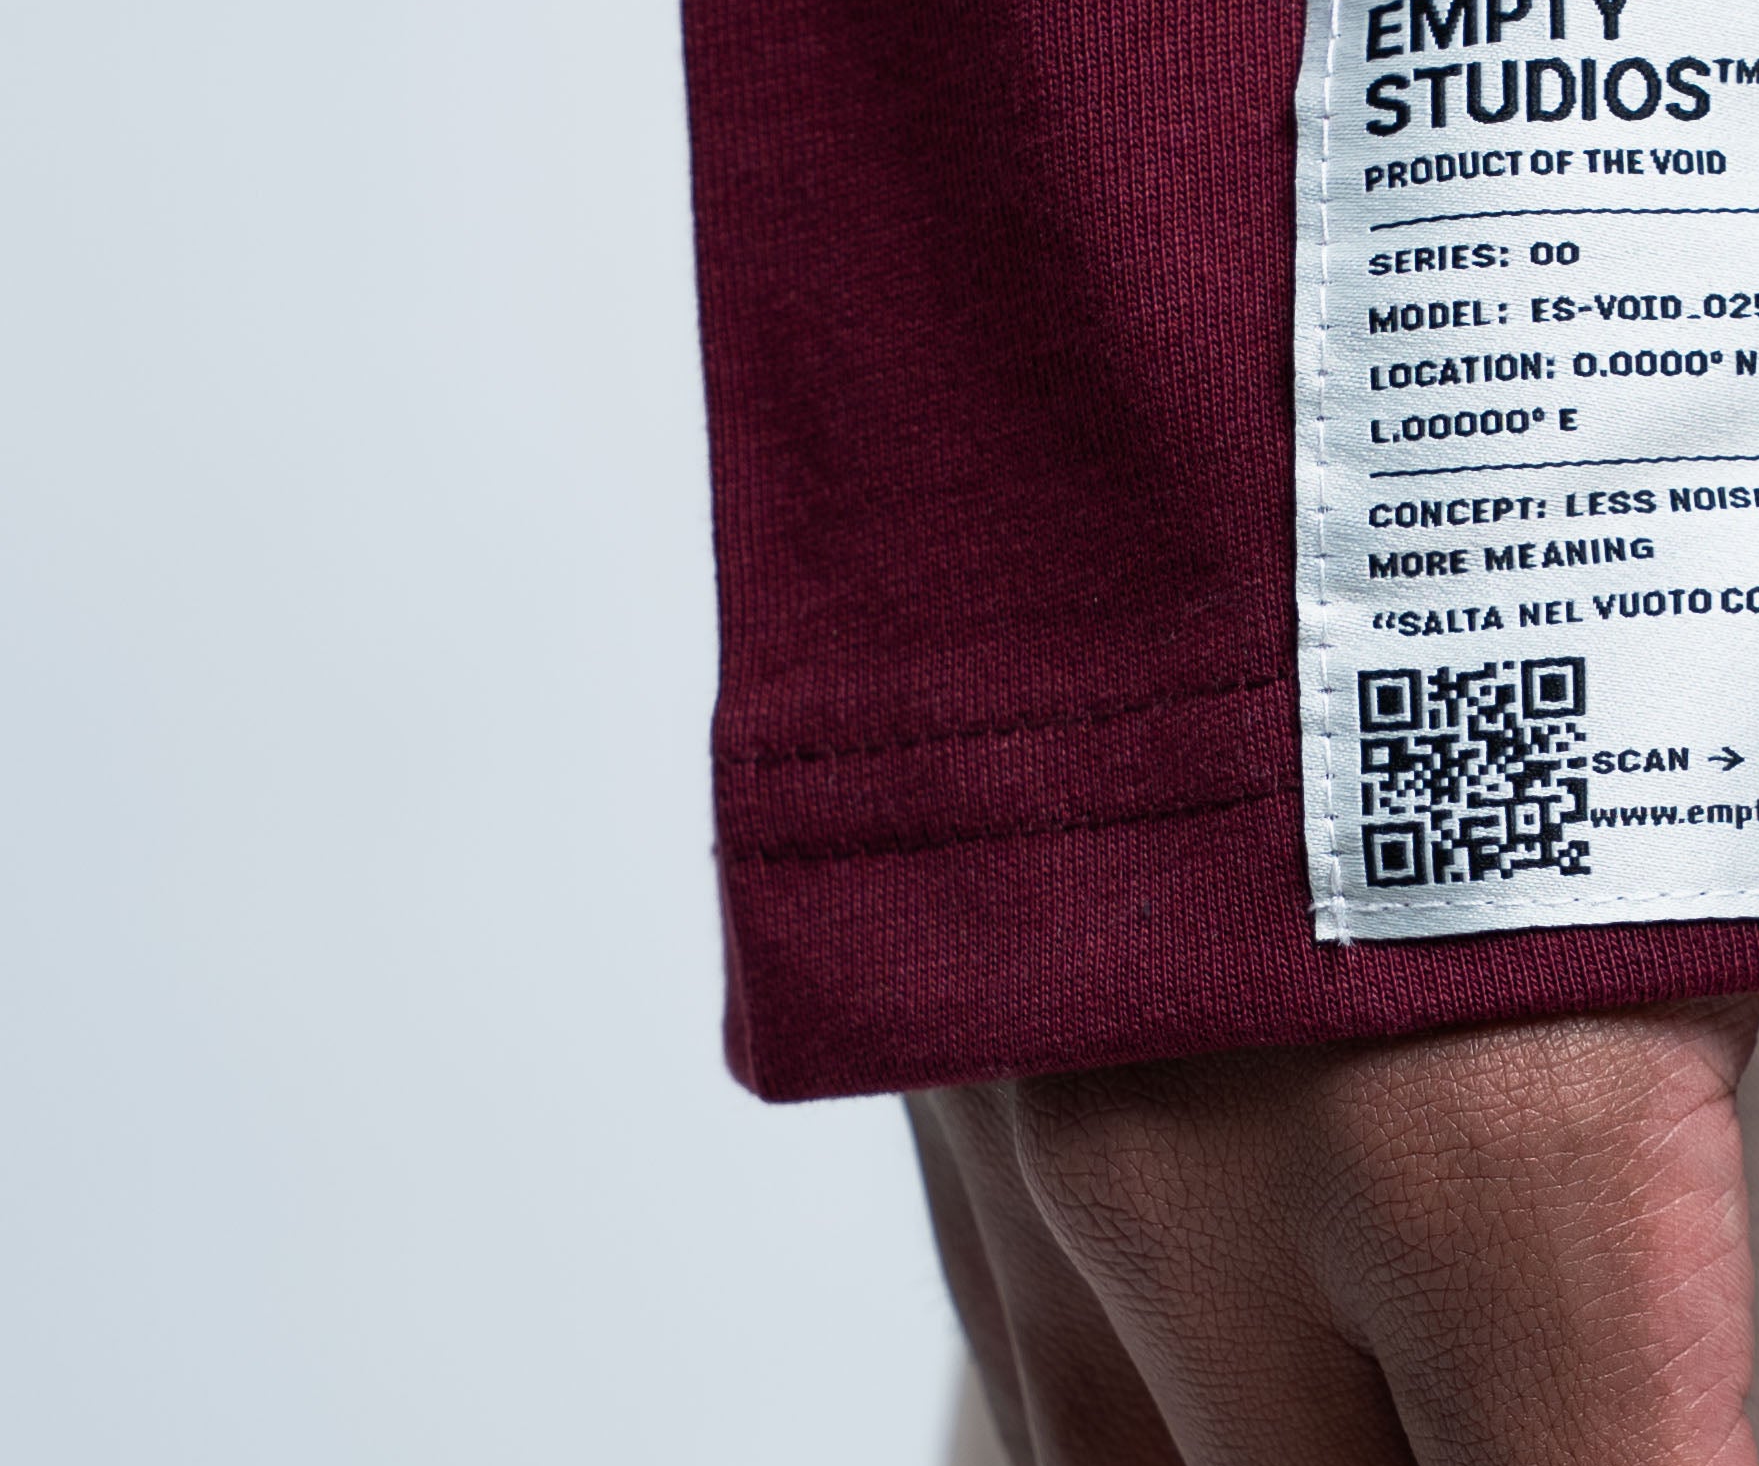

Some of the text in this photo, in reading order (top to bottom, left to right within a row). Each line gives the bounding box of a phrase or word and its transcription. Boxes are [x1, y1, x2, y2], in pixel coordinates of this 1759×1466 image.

[1364, 148, 1727, 193] PRODUCT OF THE VOID
[1368, 243, 1510, 277] SERIES:
[1368, 299, 1509, 335] MODEL:
[1369, 351, 1556, 392] LOCATION:
[1735, 349, 1758, 377] N
[1558, 407, 1579, 432] E
[1368, 496, 1547, 529] CONCEPT:
[1565, 489, 1658, 518] LESS
[1367, 537, 1655, 580] MORE MEANING
[1518, 600, 1584, 628] NEL
[1592, 587, 1713, 621] VUOTO
[1592, 746, 1690, 775] SCAN
